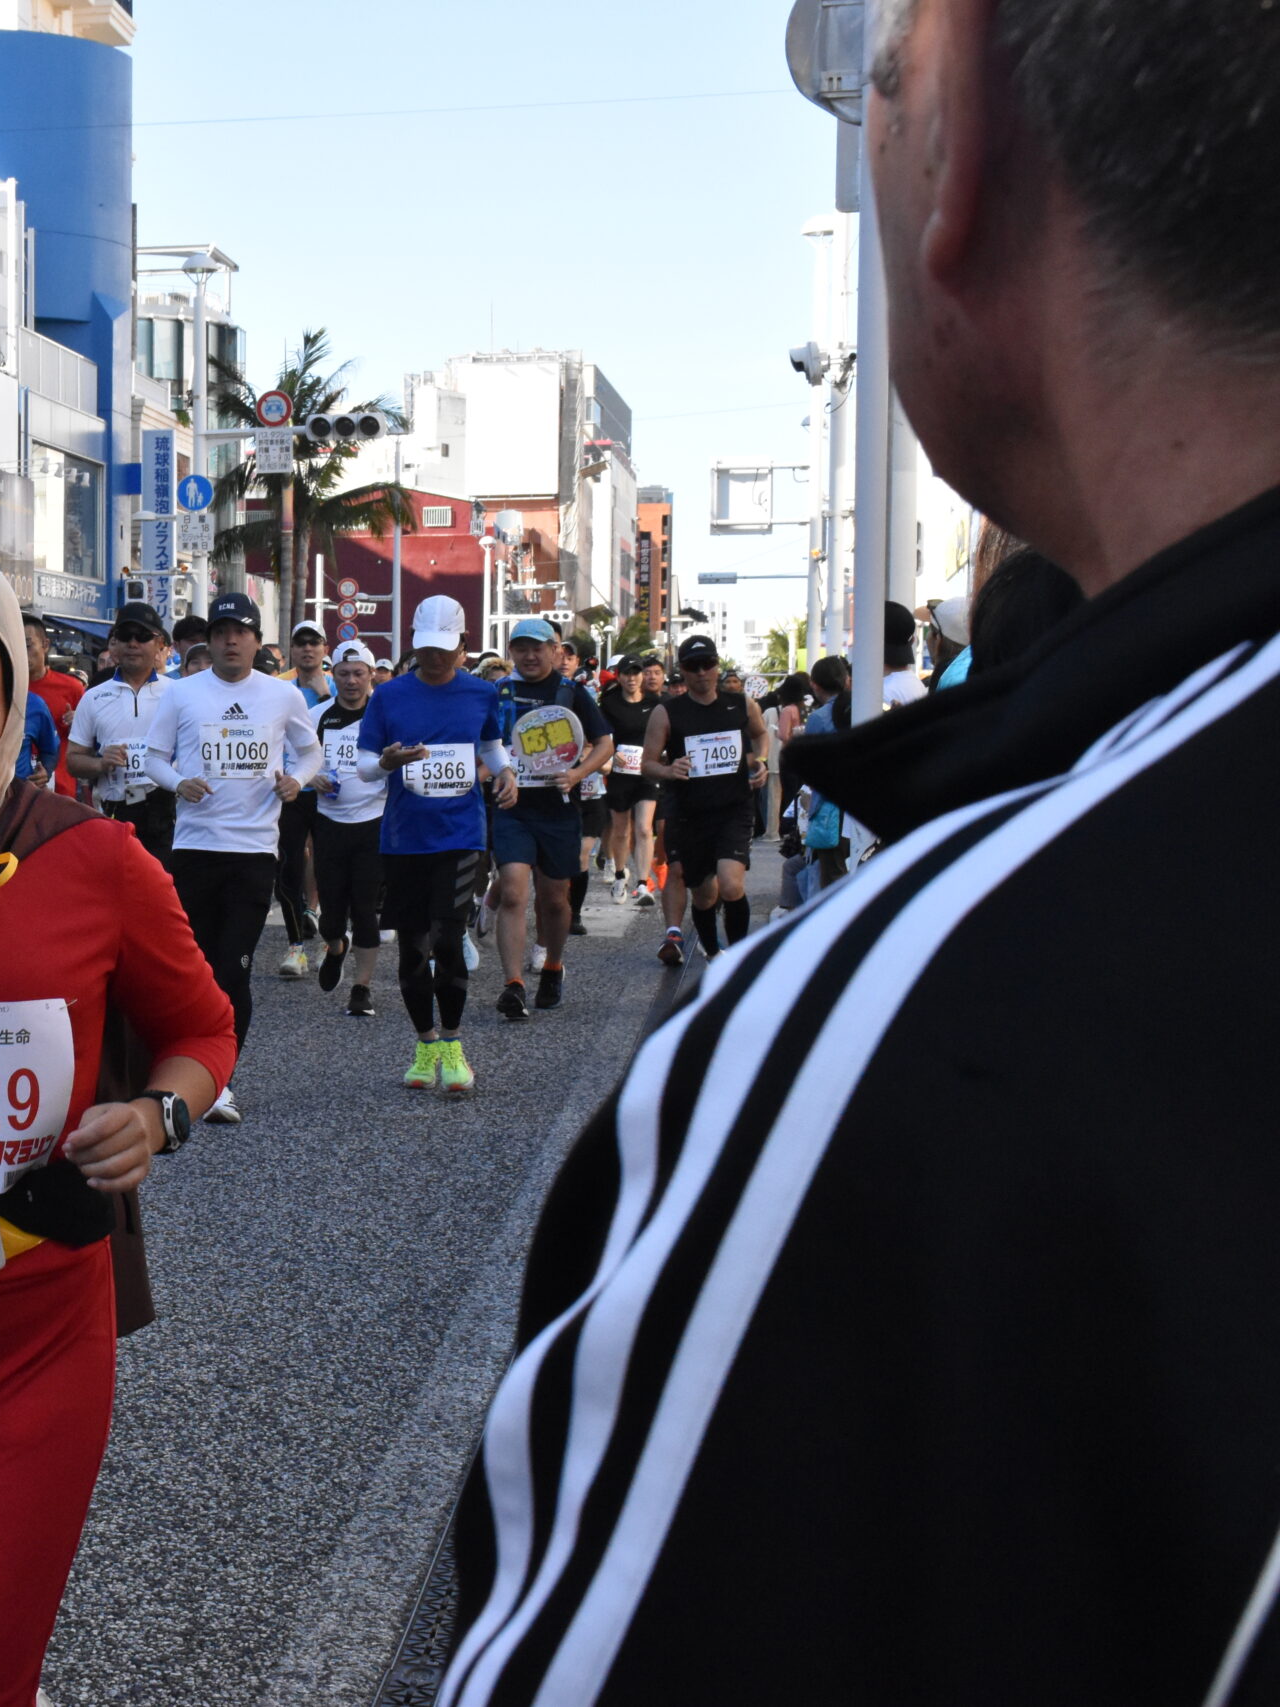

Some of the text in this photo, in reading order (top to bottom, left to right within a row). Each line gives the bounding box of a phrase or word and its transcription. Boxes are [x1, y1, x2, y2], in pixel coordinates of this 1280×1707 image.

[324, 744, 353, 759] E 48
[702, 745, 737, 762] 7409
[405, 762, 465, 781] E 5366
